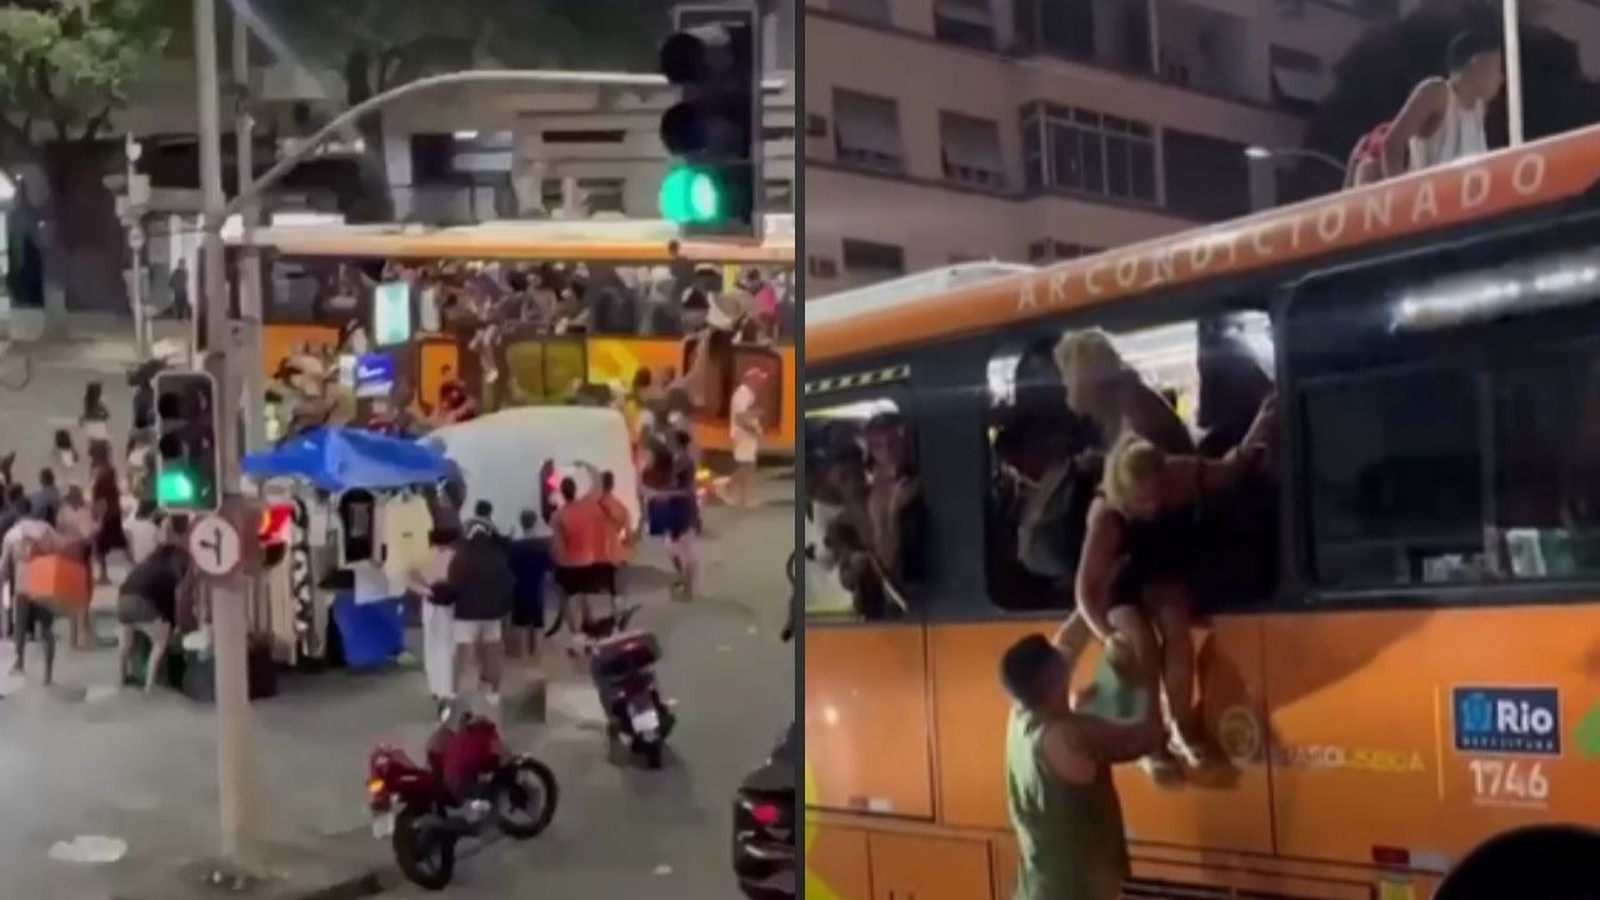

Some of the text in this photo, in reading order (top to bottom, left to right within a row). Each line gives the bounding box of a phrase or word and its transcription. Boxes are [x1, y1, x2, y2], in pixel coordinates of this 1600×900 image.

[1018, 153, 1547, 311] AR CONDICIONADO
[1497, 699, 1554, 734] Rio
[1469, 760, 1549, 799] 1746
